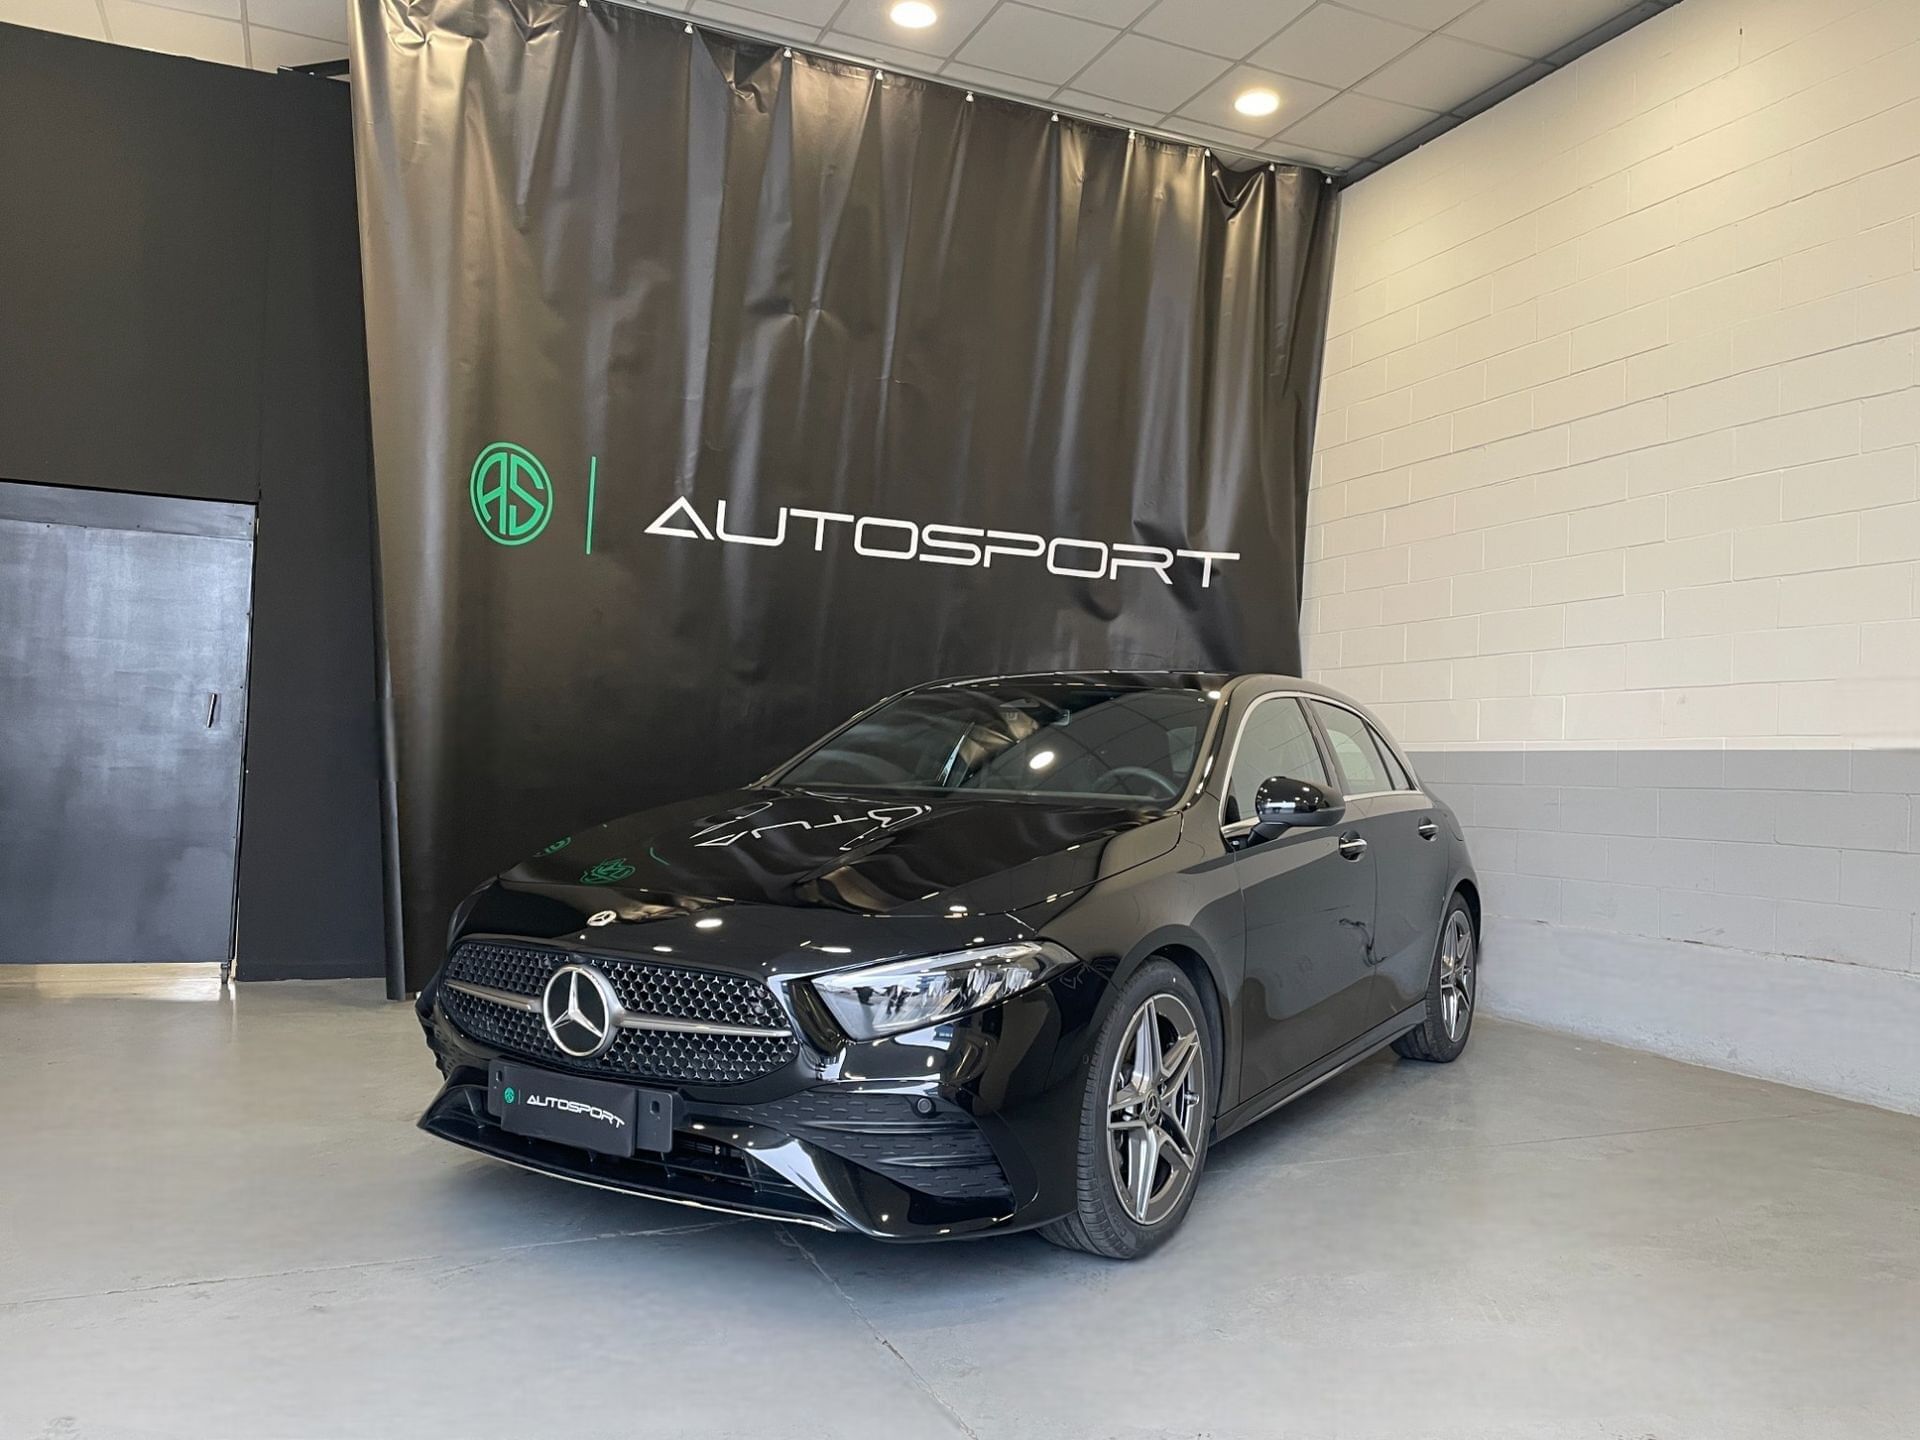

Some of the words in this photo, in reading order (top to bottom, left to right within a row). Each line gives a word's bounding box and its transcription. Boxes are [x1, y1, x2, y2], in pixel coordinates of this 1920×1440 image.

[475, 450, 546, 538] AS
[644, 495, 1240, 588] AUTOSPORT
[526, 1094, 625, 1129] AUTOSPORT
